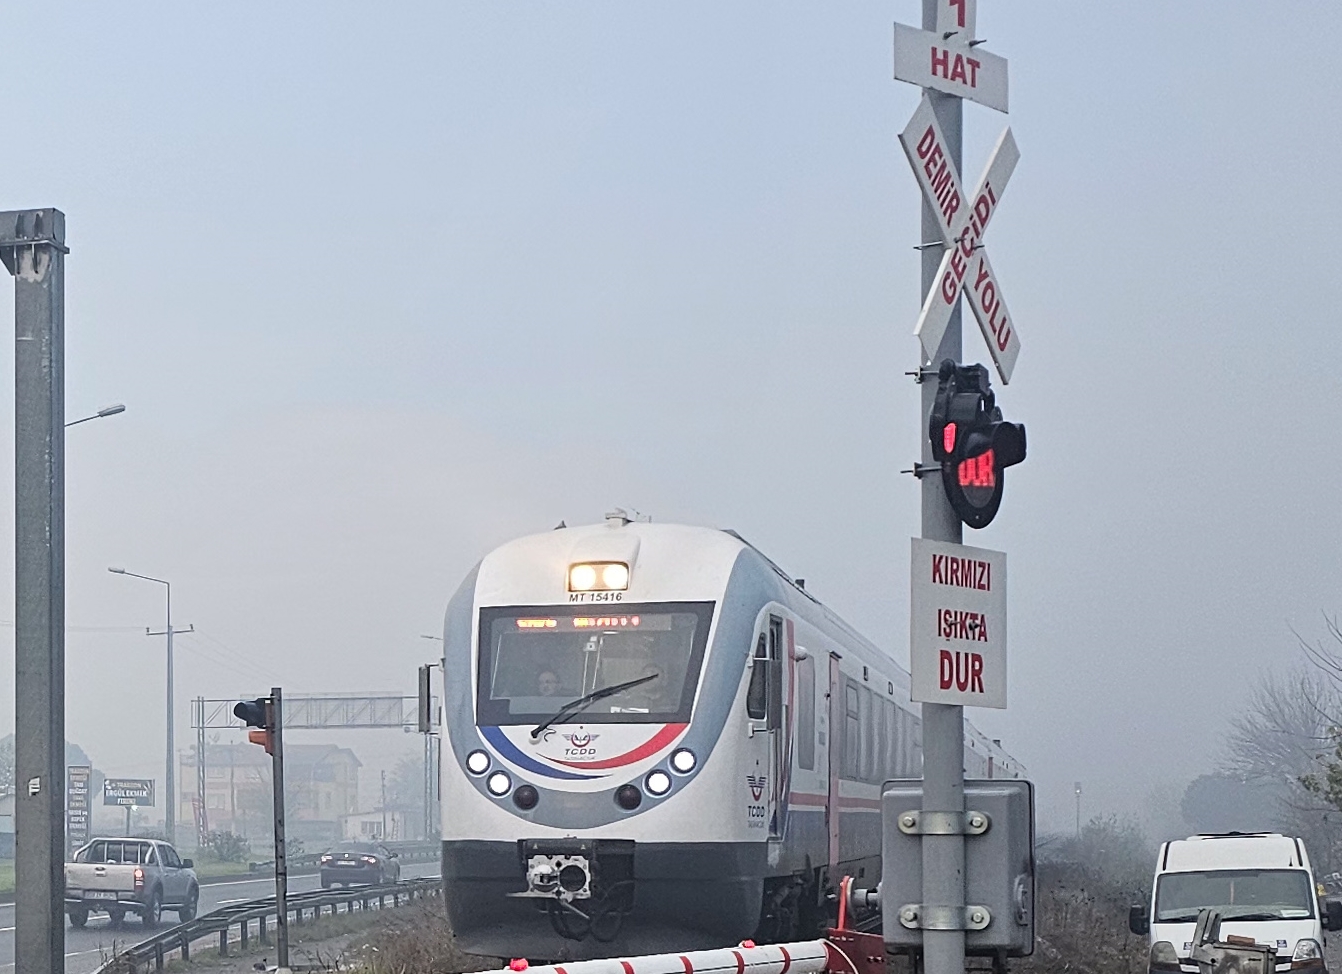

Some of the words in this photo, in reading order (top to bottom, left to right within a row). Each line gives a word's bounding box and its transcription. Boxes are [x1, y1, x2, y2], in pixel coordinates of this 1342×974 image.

[949, 0, 966, 28] 1
[931, 46, 981, 88] HAT
[916, 124, 961, 228] DEMİR
[973, 257, 1012, 353] YOLU
[931, 553, 991, 592] KIRMIZI
[569, 593, 586, 602] MT
[590, 592, 623, 602] 15416
[937, 608, 988, 642] IŞIKTA
[939, 649, 985, 694] DUR
[748, 805, 765, 817] TCDD
